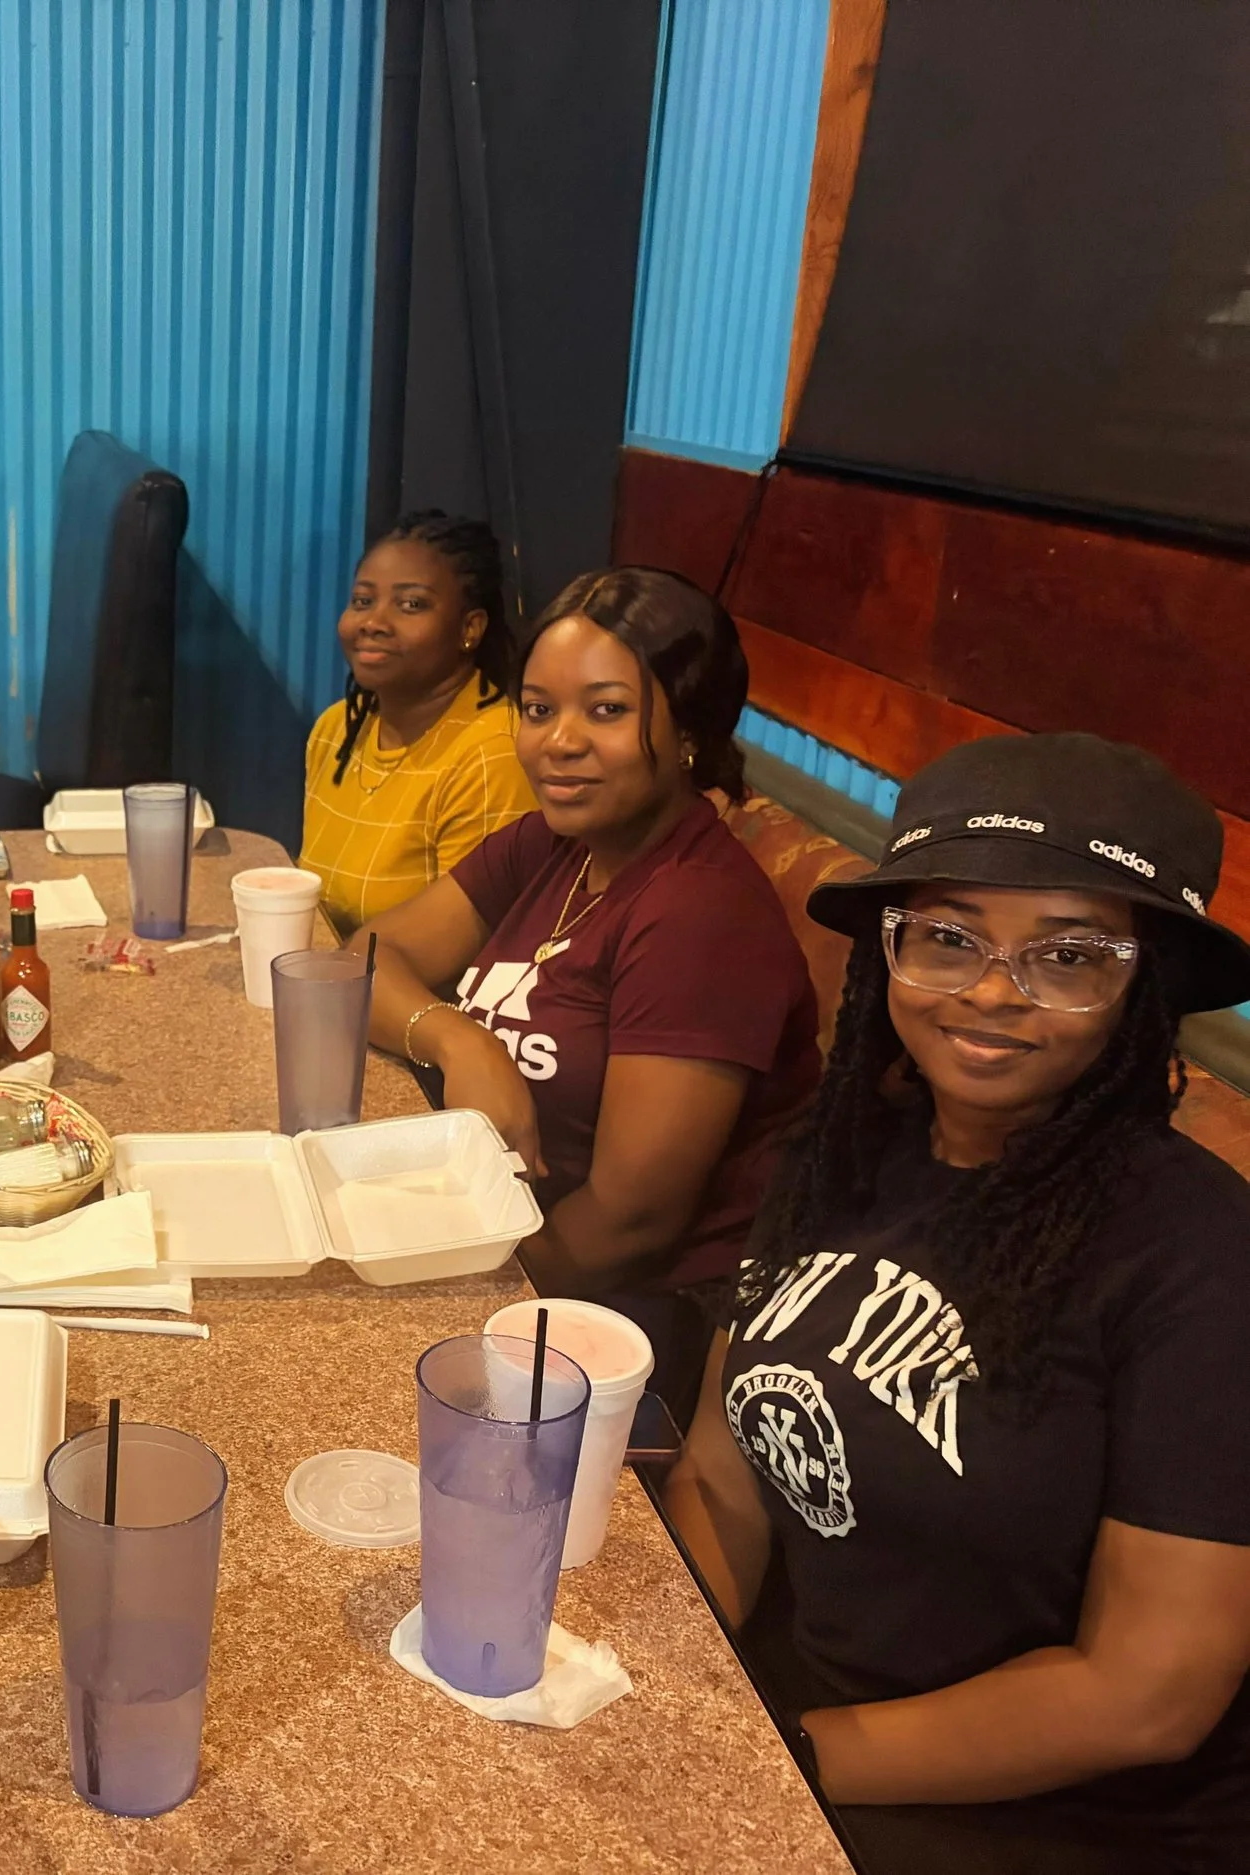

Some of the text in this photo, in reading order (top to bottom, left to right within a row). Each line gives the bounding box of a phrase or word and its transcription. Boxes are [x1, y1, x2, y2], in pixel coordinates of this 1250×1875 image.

[967, 813, 1045, 834] adidas
[1089, 839, 1156, 879] adidas
[743, 1374, 820, 1413] BROOKLYN
[751, 1435, 826, 1479] 19 96
